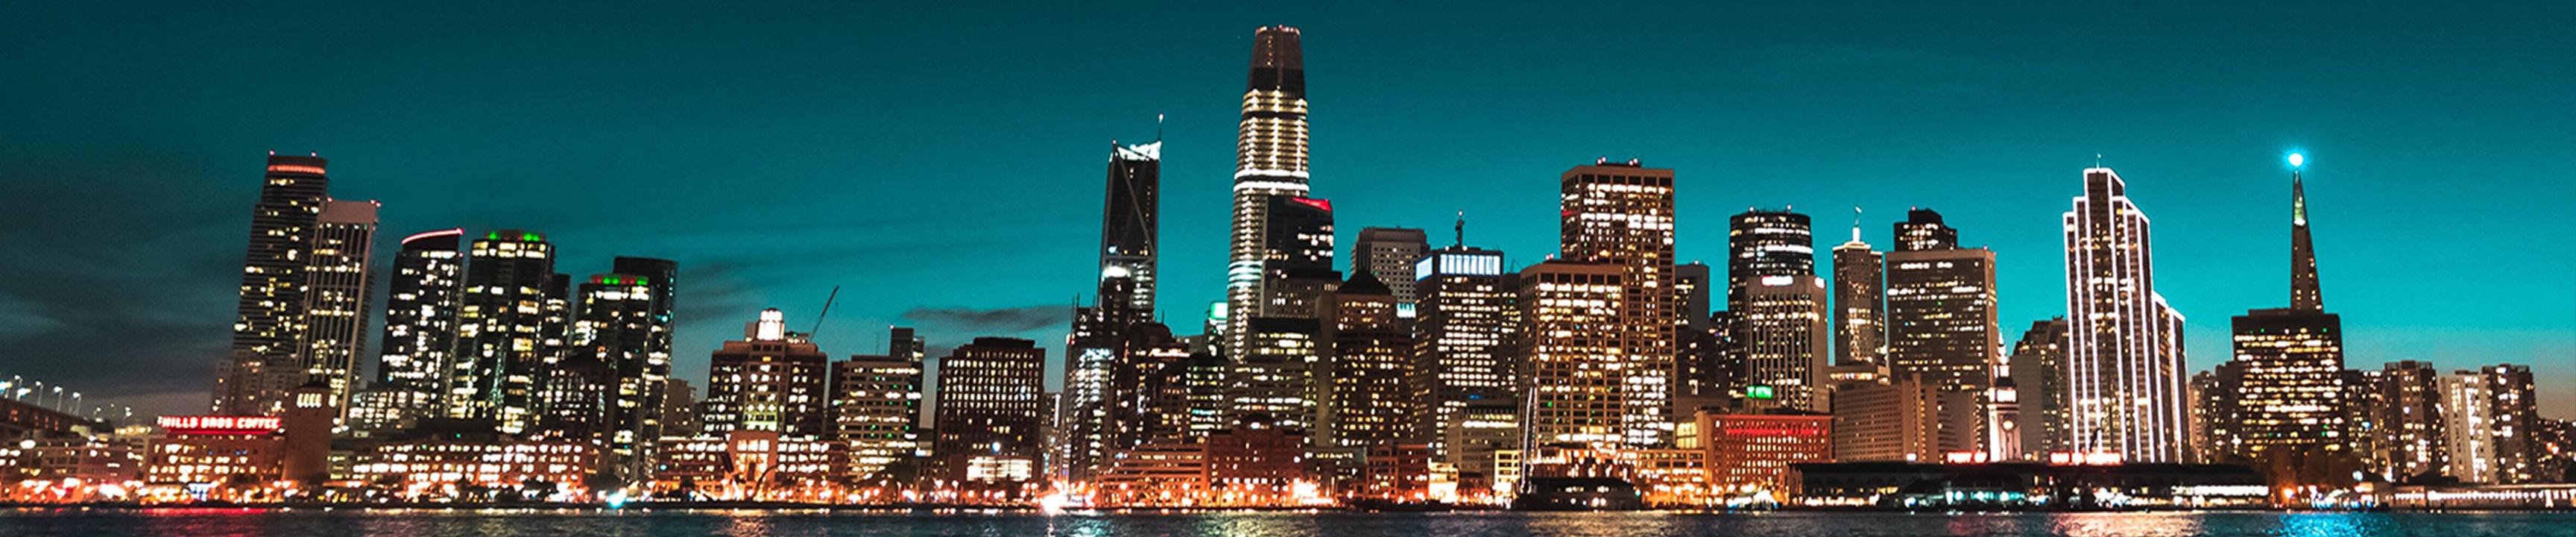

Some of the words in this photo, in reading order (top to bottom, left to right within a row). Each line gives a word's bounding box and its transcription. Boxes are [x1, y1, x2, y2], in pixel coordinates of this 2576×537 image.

[162, 417, 198, 429] HILLS
[201, 417, 233, 429] BROS
[236, 417, 280, 429] COFFEE
